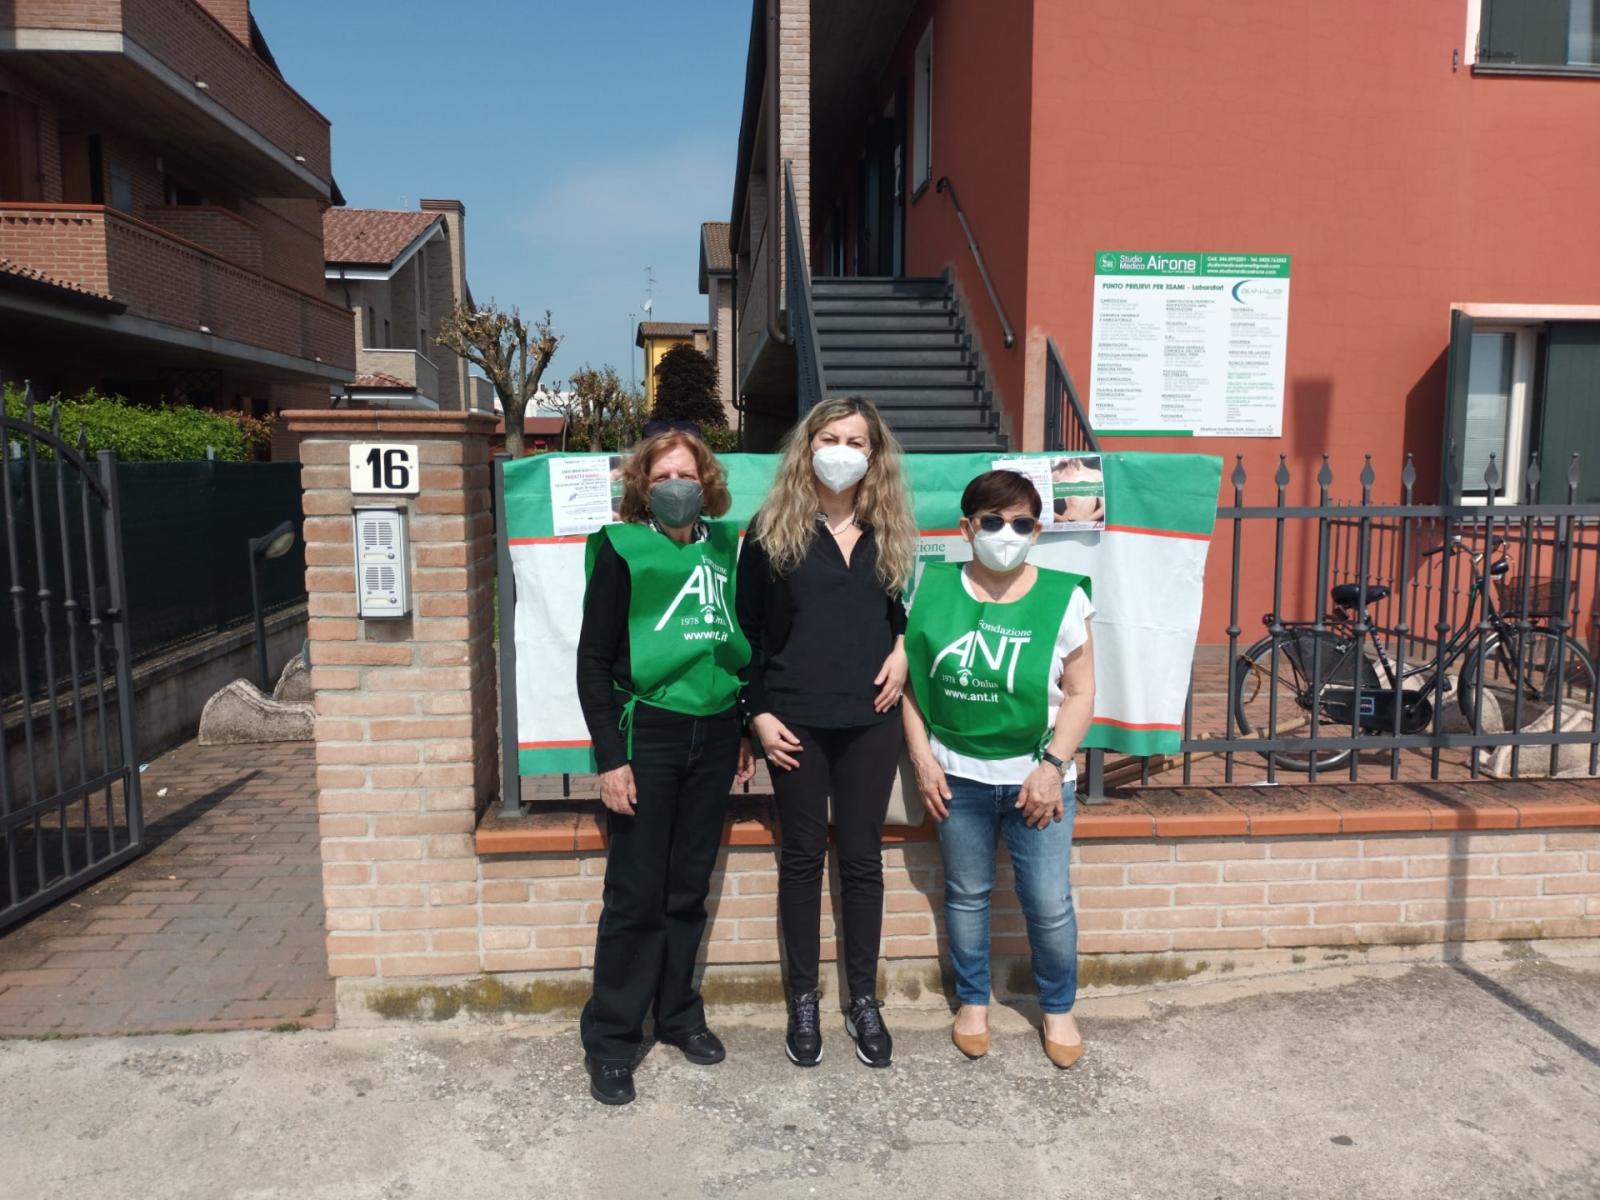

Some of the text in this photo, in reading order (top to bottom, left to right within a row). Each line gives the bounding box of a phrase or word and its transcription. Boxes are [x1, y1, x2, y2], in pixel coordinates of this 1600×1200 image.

[1119, 254, 1143, 262] Studio
[1146, 255, 1197, 270] Airone
[1119, 262, 1146, 270] Medico
[366, 448, 409, 489] 16
[654, 564, 734, 633] ANT
[680, 616, 700, 626] 1978
[977, 619, 1033, 637] Fondazione
[929, 630, 1031, 694] ANT
[971, 678, 999, 689] Onlus
[943, 688, 1000, 703] www.ant.it
